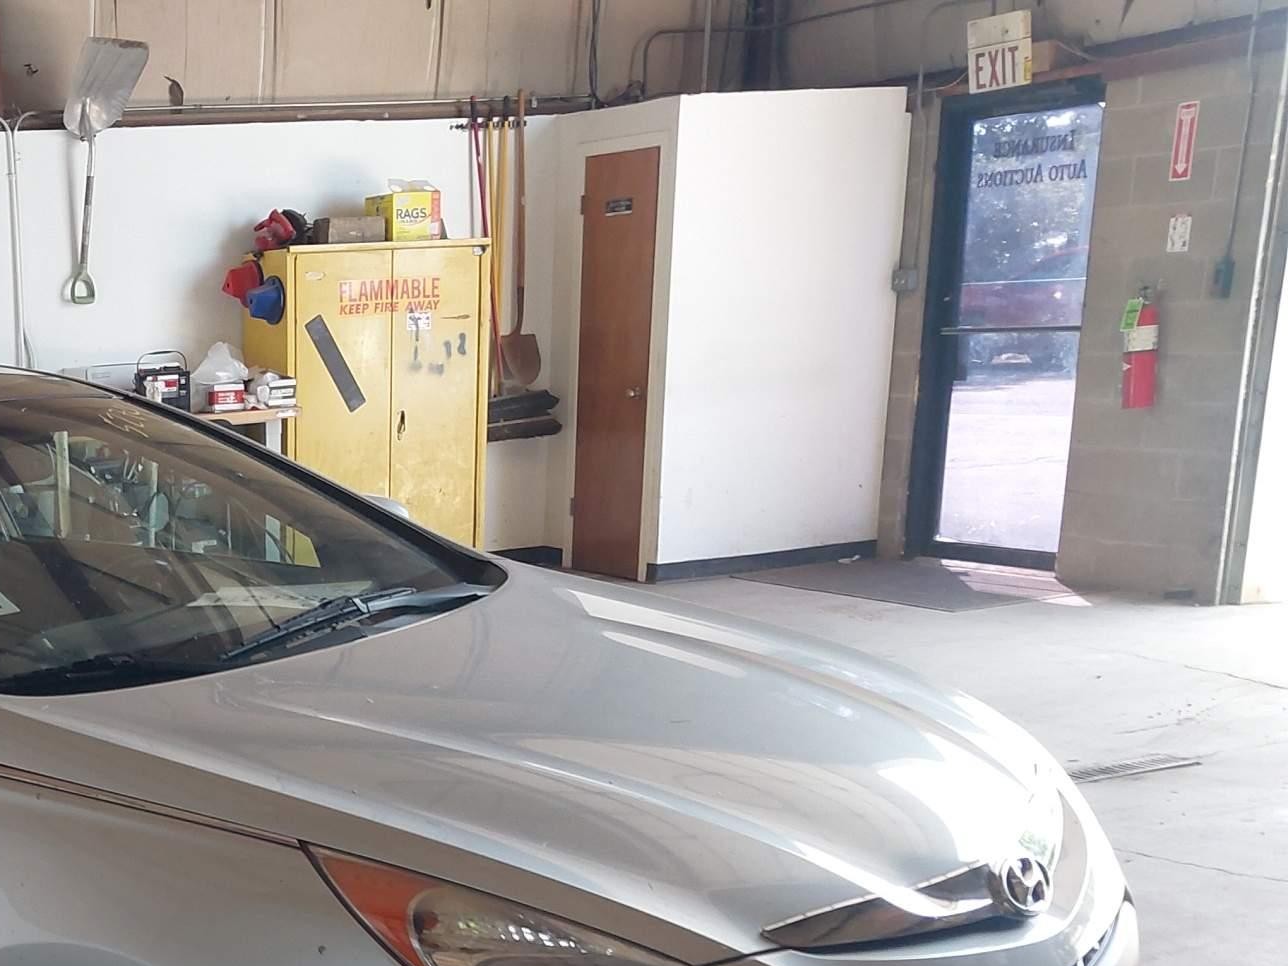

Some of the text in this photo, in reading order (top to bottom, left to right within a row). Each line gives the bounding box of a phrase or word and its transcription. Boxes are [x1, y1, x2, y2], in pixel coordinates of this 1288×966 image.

[975, 46, 1018, 90] EXIT
[396, 207, 427, 220] RAGS
[339, 277, 440, 302] FLAMMABLE
[339, 300, 440, 316] KEEP FIRE AWAY
